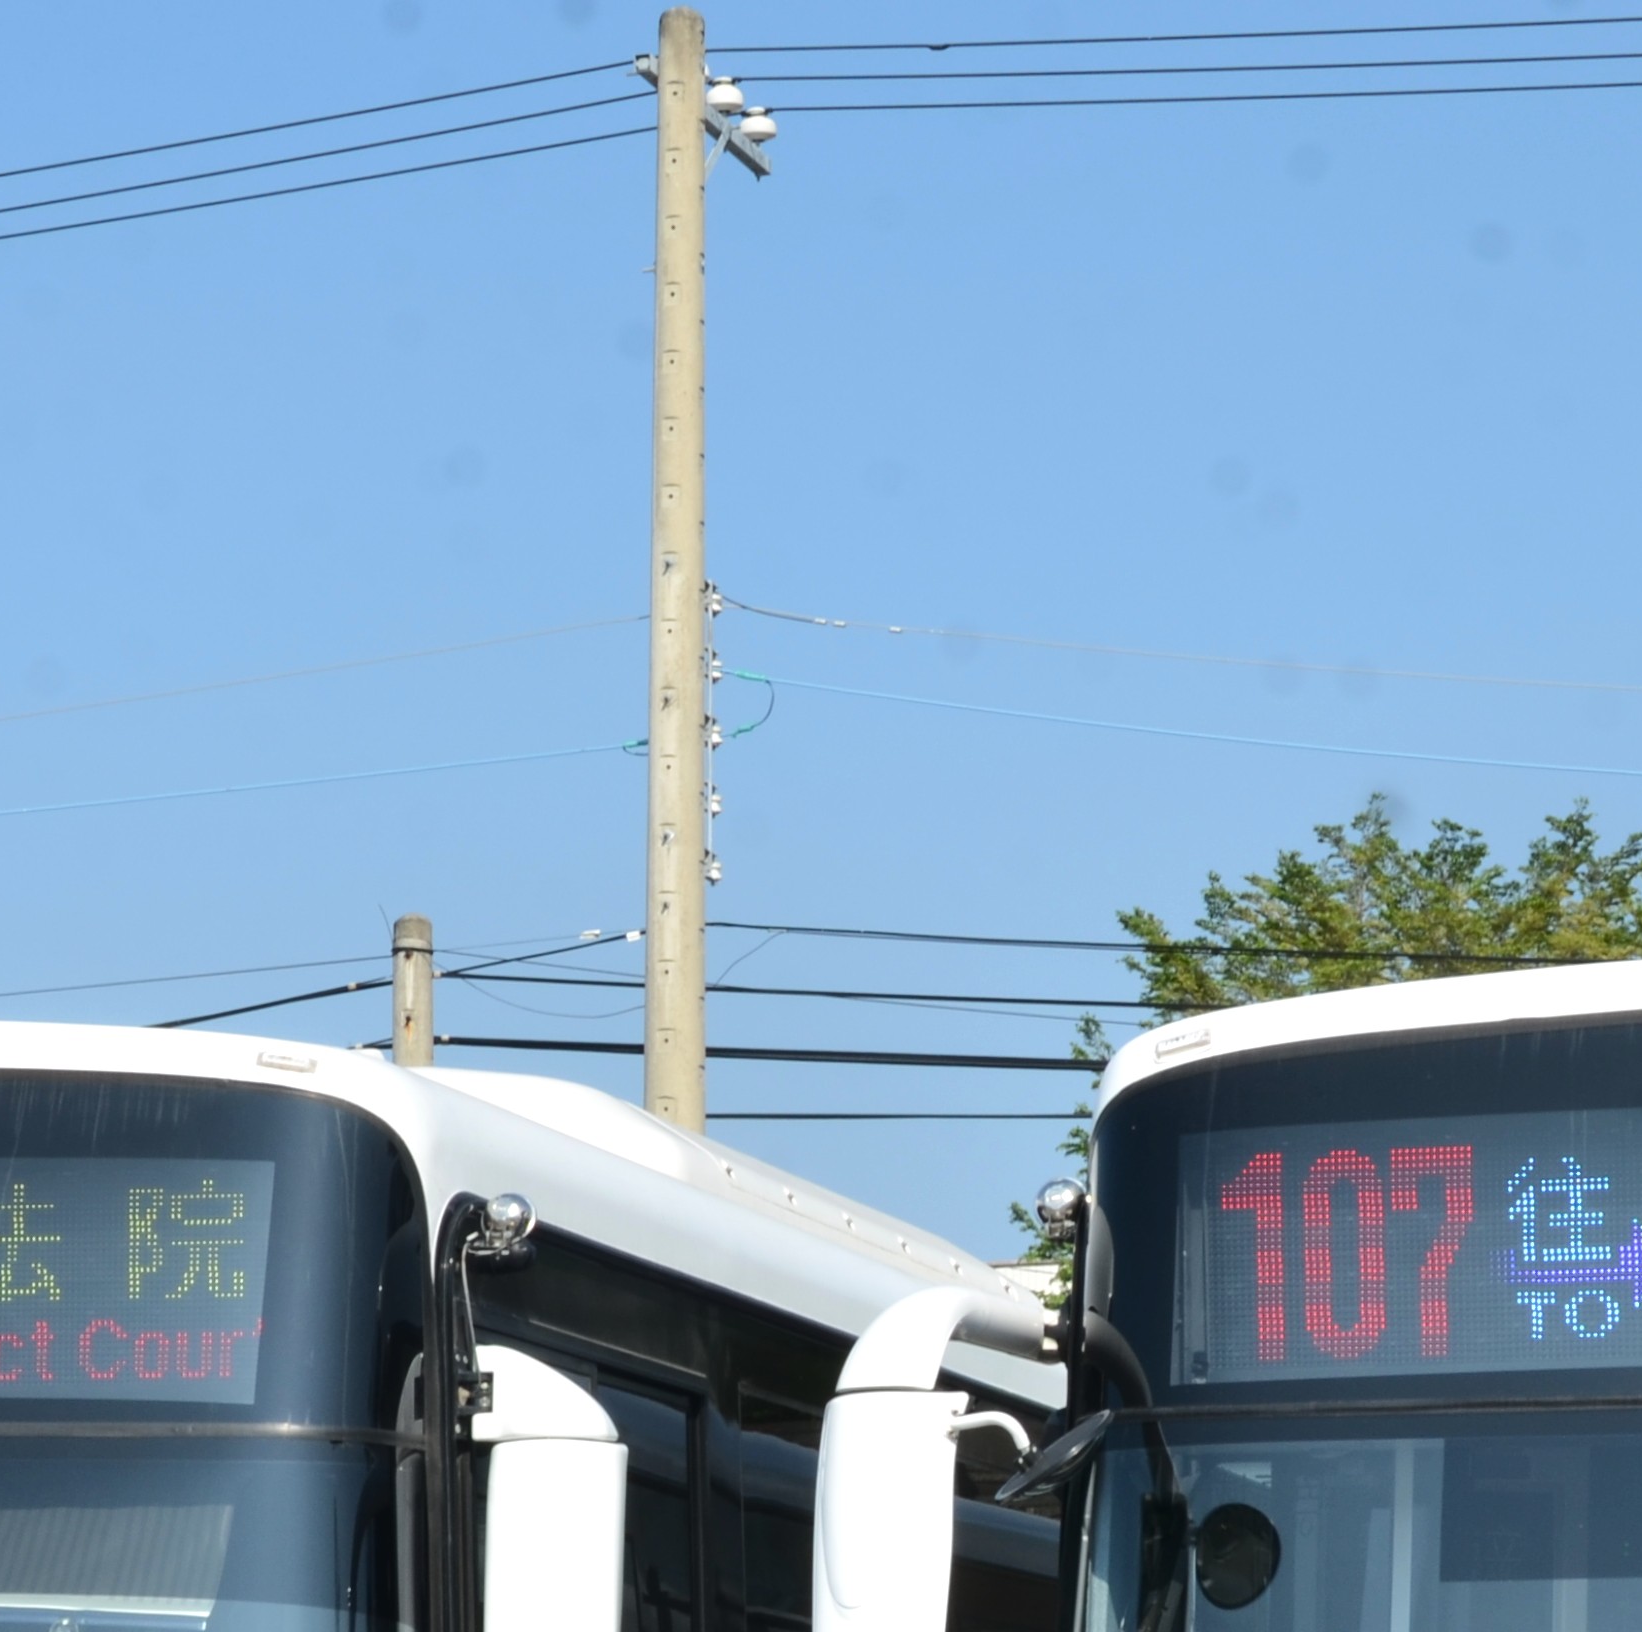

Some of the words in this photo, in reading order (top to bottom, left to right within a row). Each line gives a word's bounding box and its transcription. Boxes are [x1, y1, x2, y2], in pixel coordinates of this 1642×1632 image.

[1219, 1143, 1476, 1361] 107
[1508, 1155, 1613, 1264] 往
[1516, 1288, 1621, 1341] TO
